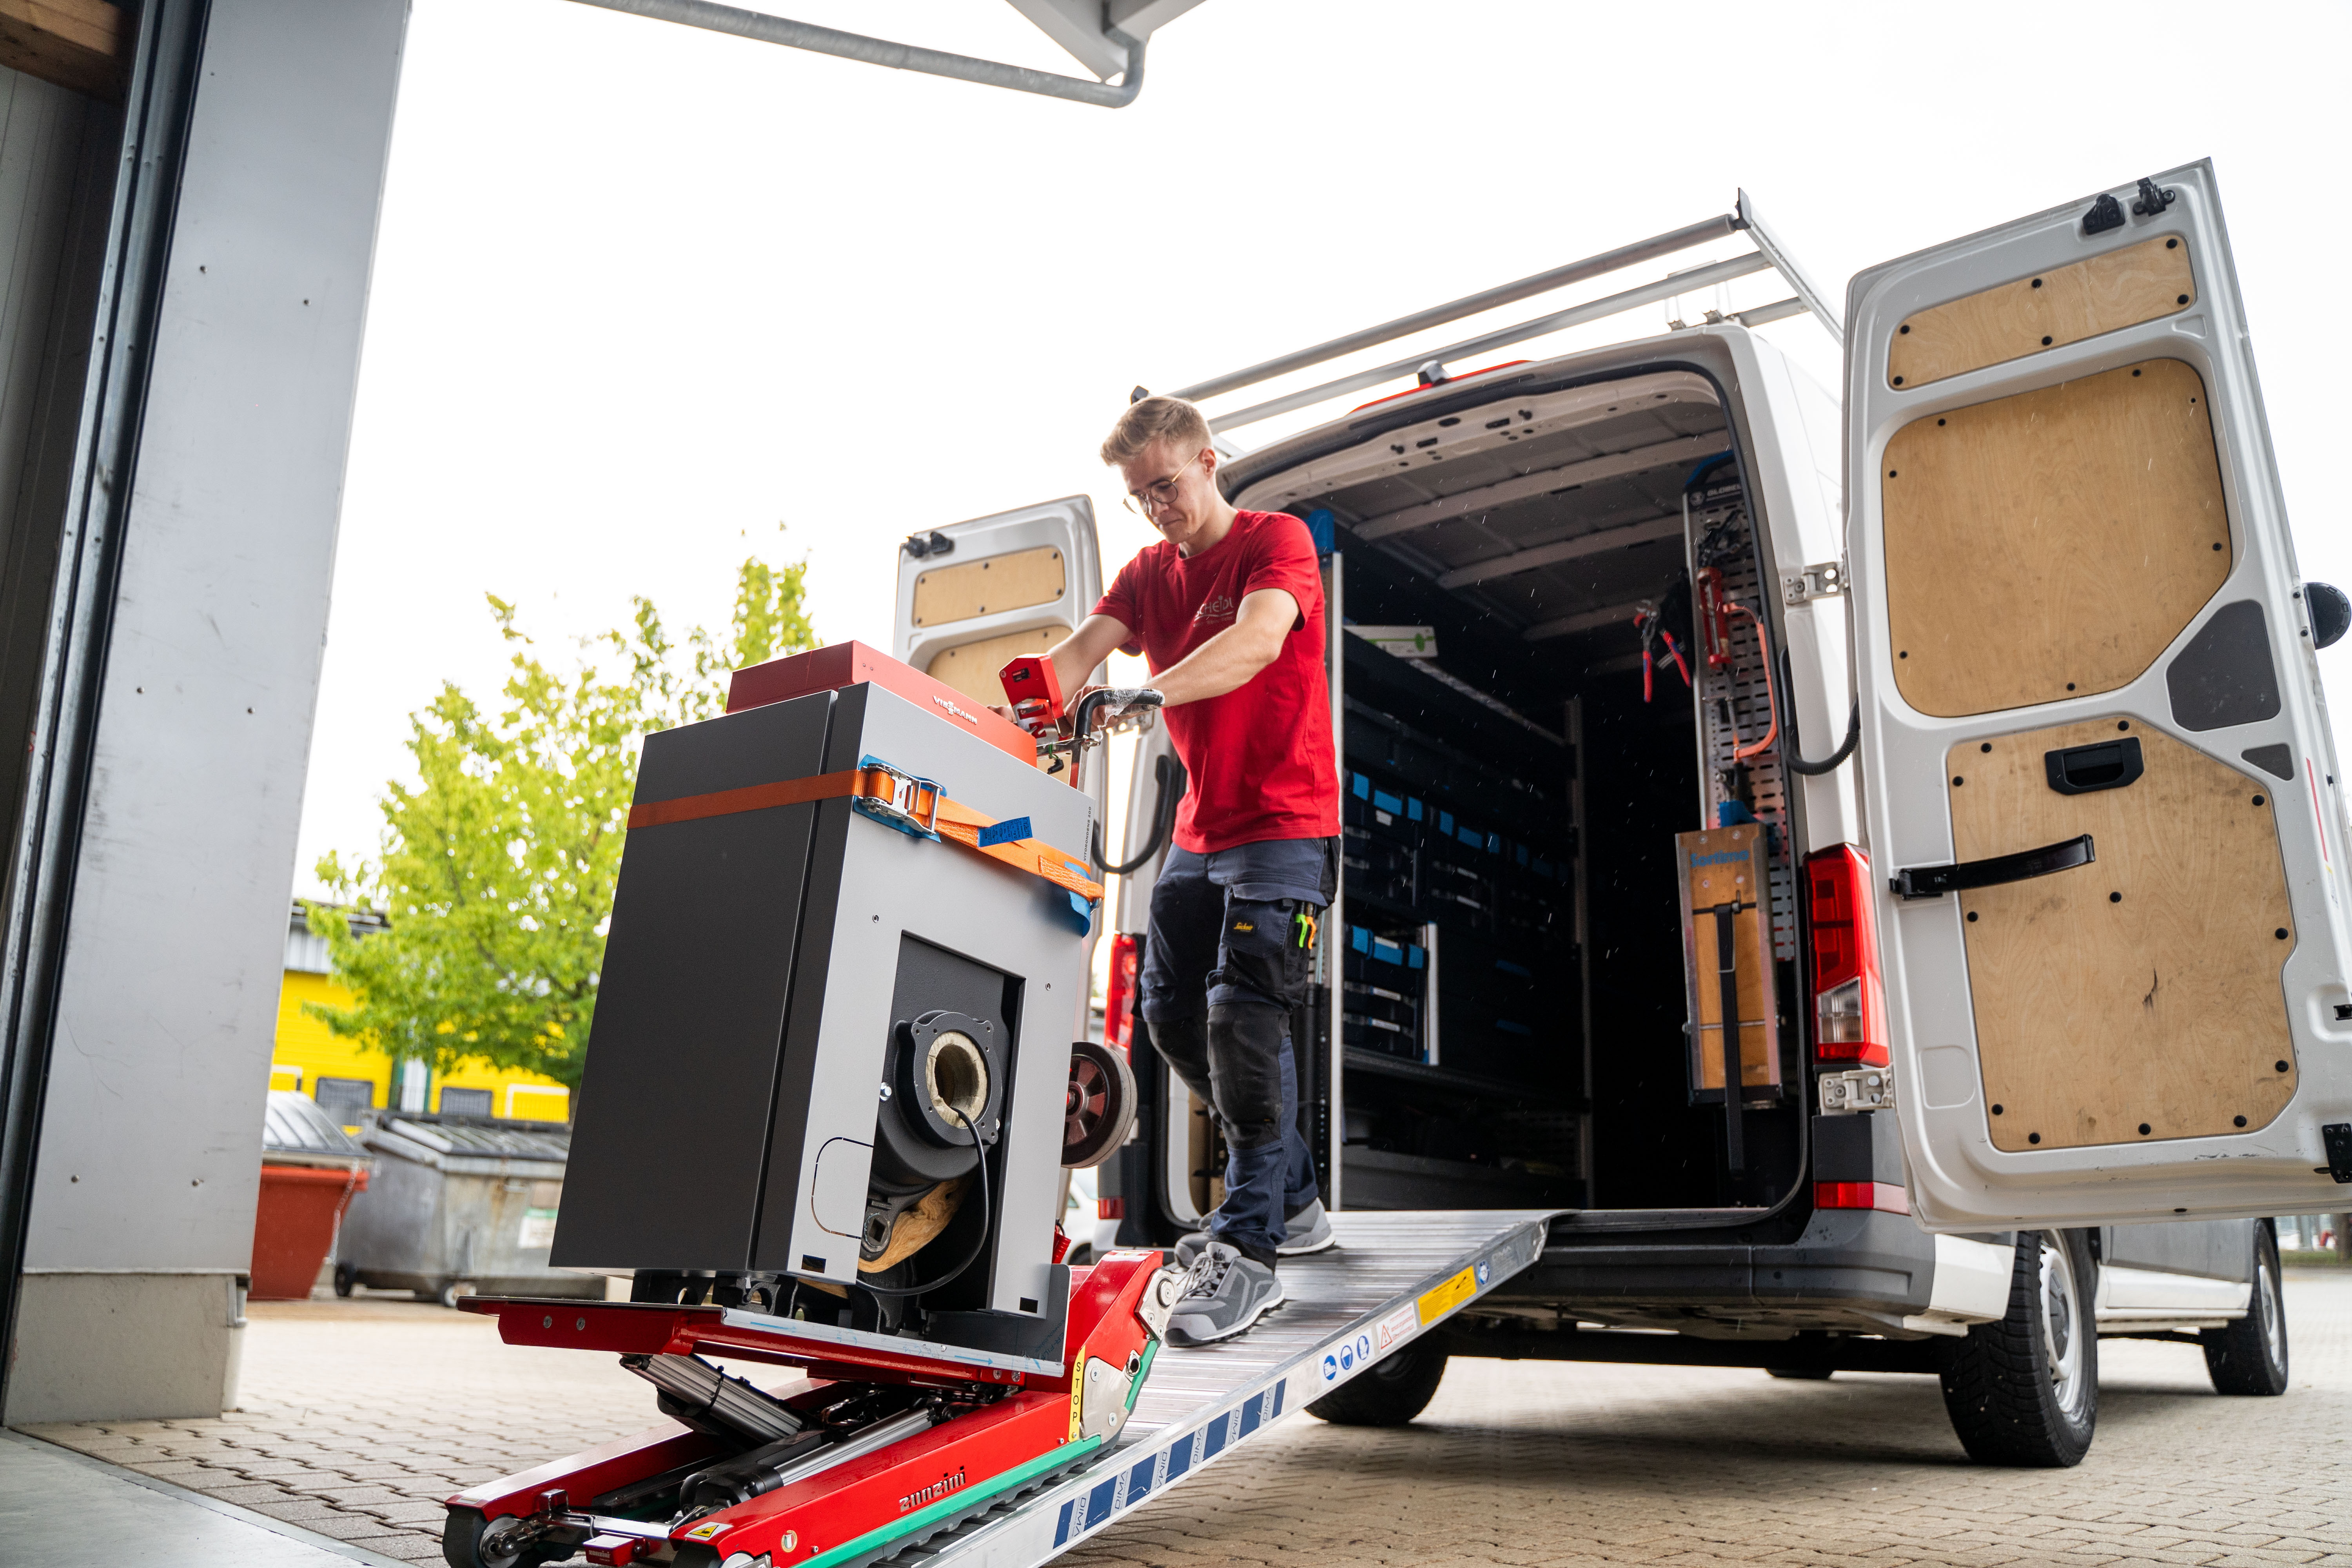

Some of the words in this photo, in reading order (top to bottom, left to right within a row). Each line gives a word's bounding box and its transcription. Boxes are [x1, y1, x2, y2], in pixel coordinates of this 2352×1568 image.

[933, 695, 978, 725] VIESSMANN
[1690, 849, 1749, 867] Sortimo
[1073, 1362, 1081, 1422] STOP
[1263, 1387, 1272, 1421] DIMA
[1193, 1427, 1203, 1463] DIMA
[1230, 1410, 1240, 1445] DIMA
[1157, 1452, 1167, 1488] DIMA
[1114, 1471, 1126, 1509] DIMA
[1074, 1497, 1086, 1537] DIMA
